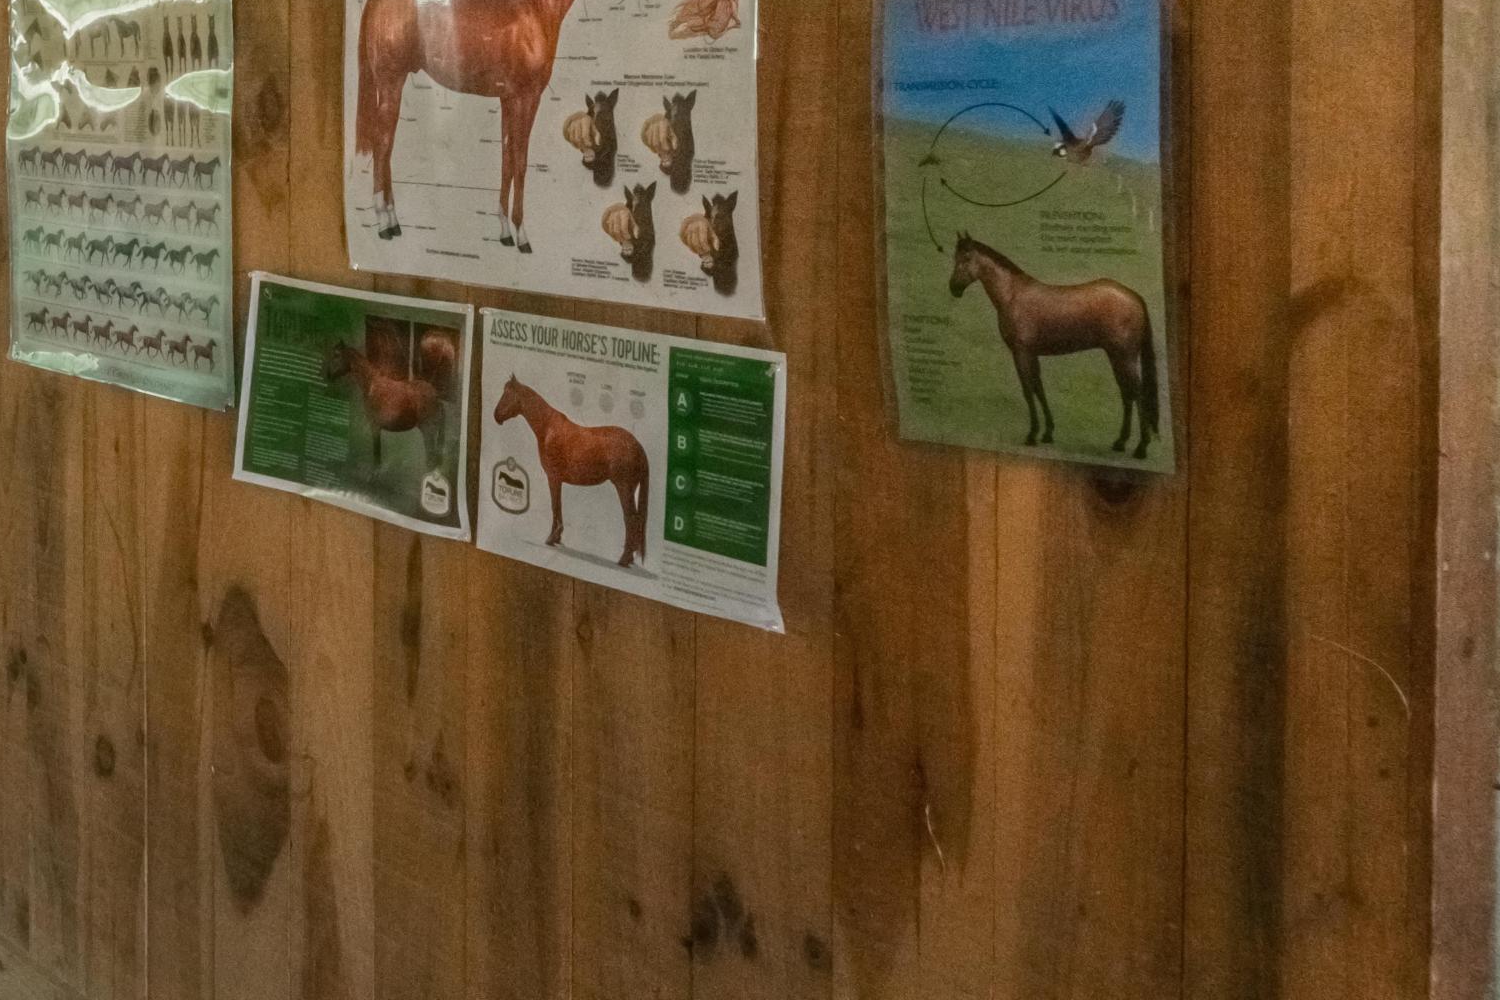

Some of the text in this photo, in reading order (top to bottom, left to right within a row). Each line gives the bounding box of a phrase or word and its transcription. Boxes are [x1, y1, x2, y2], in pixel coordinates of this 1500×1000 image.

[490, 318, 528, 342] ASSESS
[531, 324, 559, 348] YOUR
[562, 329, 608, 356] HORSE'S
[677, 392, 688, 408] A
[677, 435, 687, 450] B
[675, 475, 685, 490] C
[674, 516, 684, 531] D
